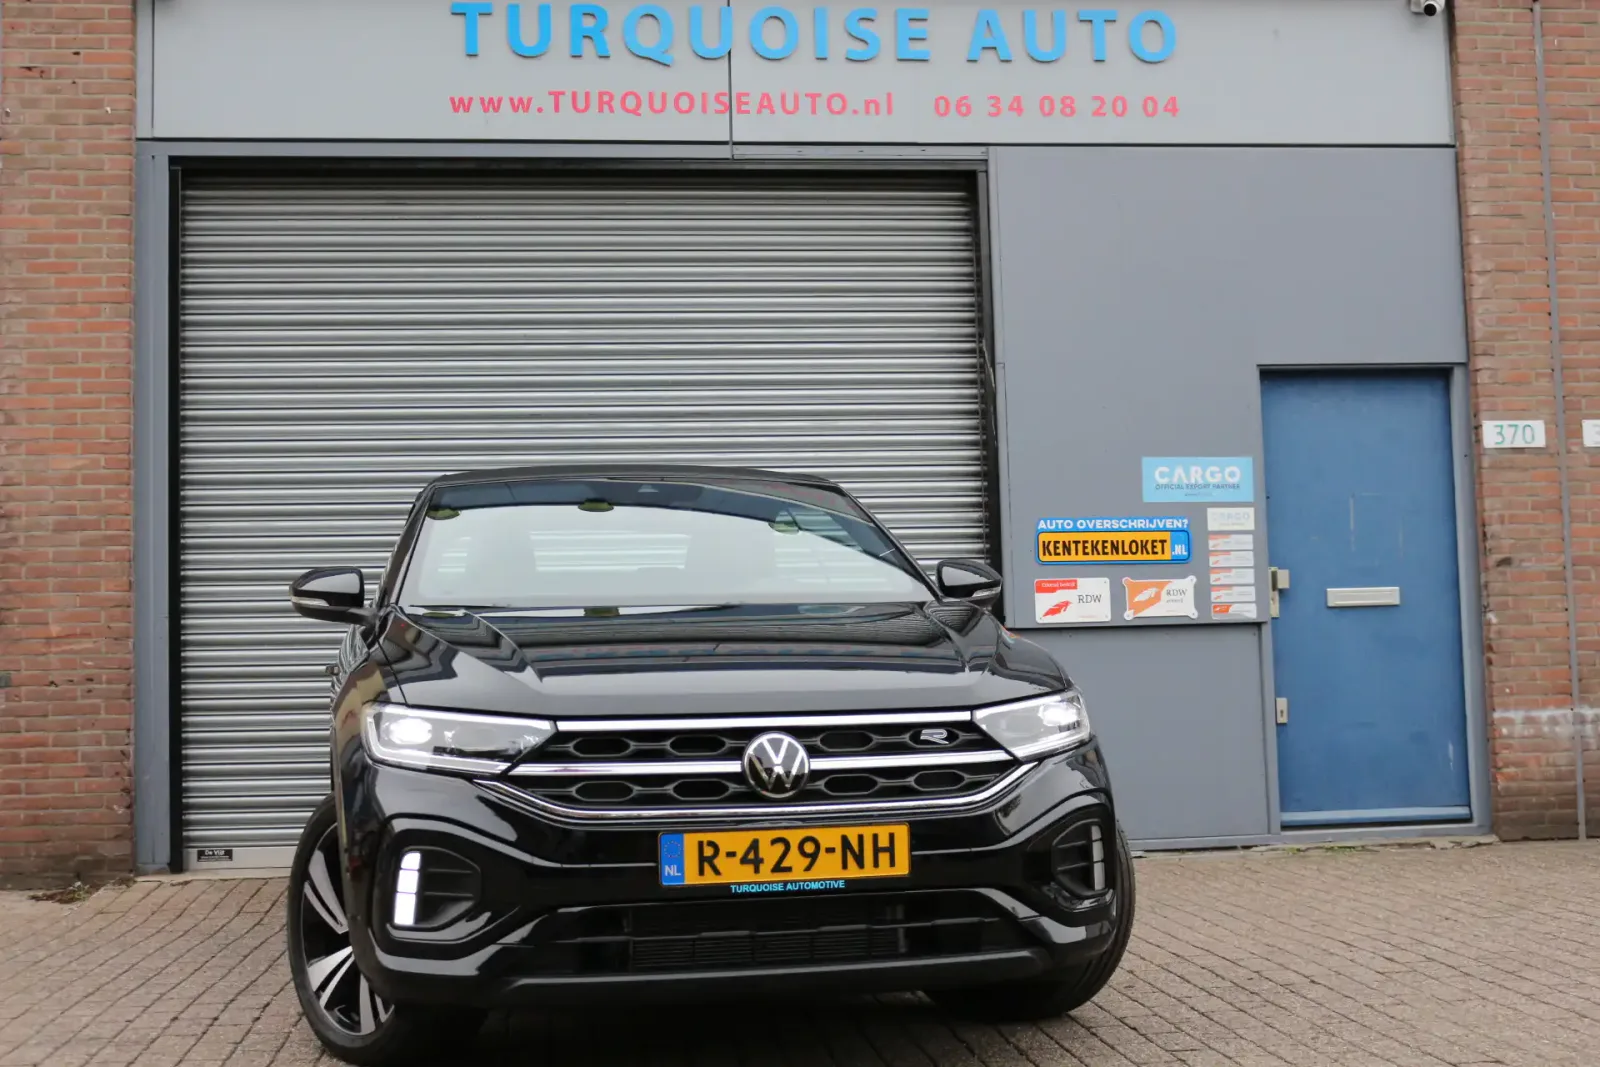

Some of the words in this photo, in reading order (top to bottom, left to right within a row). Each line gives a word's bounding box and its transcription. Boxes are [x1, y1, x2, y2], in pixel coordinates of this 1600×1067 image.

[450, 2, 931, 67] TURQUOISE
[966, 9, 1178, 63] AUTO
[449, 91, 894, 117] www.TURQUOISEAUTO.nl
[933, 95, 973, 118] 06
[986, 95, 1025, 118] 34
[1038, 95, 1077, 118] 08
[1091, 95, 1129, 118] 20
[1141, 95, 1181, 118] 04
[1493, 423, 1536, 445] 370
[1154, 465, 1241, 484] CARGO
[1037, 519, 1074, 529] AUTO
[1076, 518, 1189, 529] OVERSCHRIJVEN?
[1041, 539, 1168, 557] KENTEKENLOKET
[1077, 594, 1102, 604] RDW
[1165, 588, 1188, 597] RDW
[696, 831, 897, 877] R-429-NH
[664, 864, 681, 877] NL
[730, 882, 785, 893] TURQUOISE
[785, 880, 846, 892] AUTOMOTIVE
